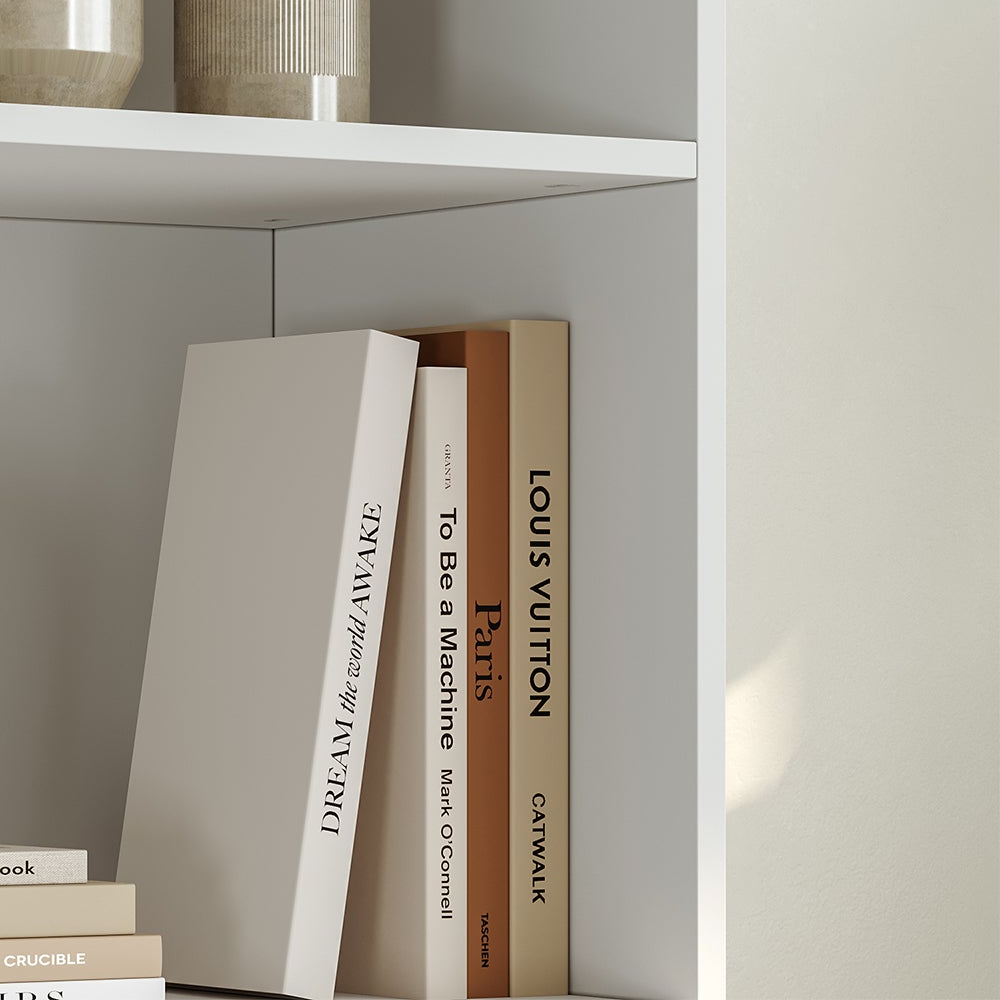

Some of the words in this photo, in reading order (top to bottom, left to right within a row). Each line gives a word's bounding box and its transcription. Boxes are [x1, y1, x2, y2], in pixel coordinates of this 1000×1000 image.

[440, 508, 456, 540] To
[530, 471, 550, 567] LOUIS
[352, 503, 382, 615] AWAKE
[440, 552, 456, 589] Be
[440, 600, 452, 615] a
[348, 615, 366, 677] world
[475, 600, 502, 701] Paris
[530, 578, 550, 716] VUITTON
[339, 680, 358, 714] the
[441, 629, 457, 749] Machine
[321, 719, 354, 836] DREAM
[441, 770, 452, 817] Mark
[532, 793, 545, 903] CATWALK
[4, 953, 85, 967] CRUCIBLE
[481, 913, 489, 967] TASCHEN
